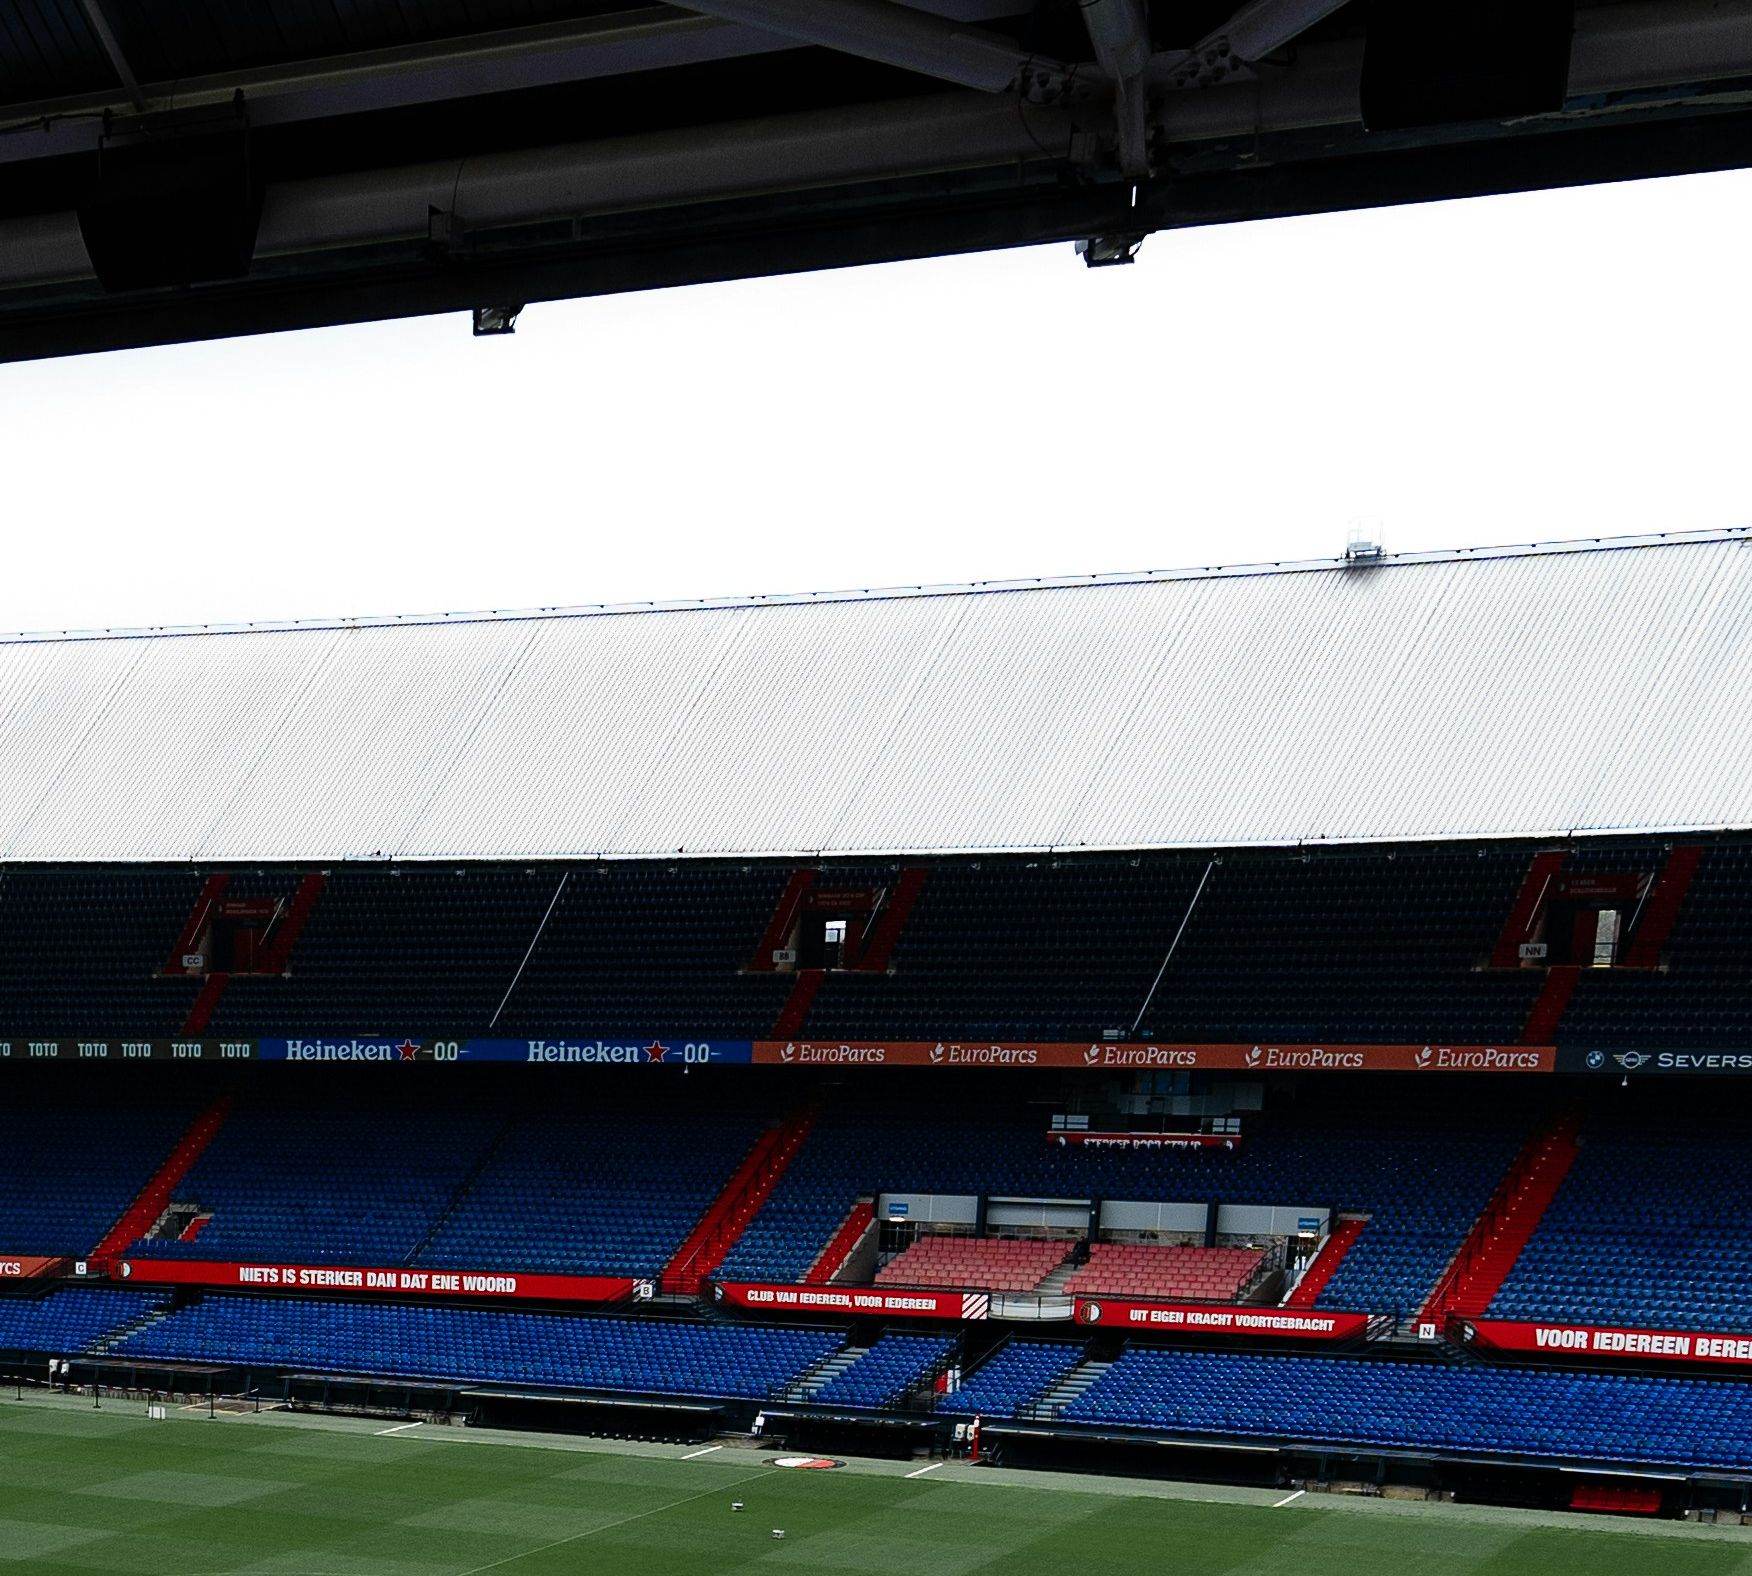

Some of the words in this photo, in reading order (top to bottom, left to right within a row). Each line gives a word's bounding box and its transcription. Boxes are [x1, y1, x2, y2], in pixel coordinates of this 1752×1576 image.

[1525, 946, 1541, 955] NN
[187, 957, 199, 965] CC
[28, 1042, 58, 1058] TOTO
[78, 1042, 107, 1058] TOTO
[121, 1042, 151, 1058] TOTO
[171, 1042, 201, 1058] TOTO
[220, 1042, 250, 1058] TOTO
[285, 1040, 393, 1061] Heineken
[526, 1040, 640, 1062] Heineken
[799, 1044, 885, 1062] EuroParcs
[948, 1045, 1038, 1063] EuroParcs
[1104, 1046, 1197, 1065] EuroParcs
[1266, 1048, 1364, 1067] EuroParcs
[1437, 1048, 1540, 1068] EuroParcs
[78, 1264, 84, 1272] C
[239, 1267, 279, 1283] NIETS
[282, 1269, 296, 1284] IS
[299, 1270, 363, 1287] STERKER
[366, 1272, 396, 1288] DAN
[400, 1273, 428, 1289] DAT
[431, 1275, 459, 1291] ENE
[462, 1276, 516, 1292] WOORD
[643, 1286, 650, 1295] B
[747, 1290, 774, 1303] CLUB
[776, 1290, 797, 1304] VAN
[799, 1291, 852, 1308] IEDEREEN,
[854, 1294, 883, 1308] VOOR
[884, 1296, 936, 1311] IEDEREEN
[1130, 1309, 1149, 1321] UIT
[1150, 1310, 1184, 1324] EIGEN
[1186, 1312, 1233, 1326] KRACHT
[1235, 1314, 1335, 1331] VOORTGEBRACHT
[1423, 1327, 1431, 1336] N
[1535, 1328, 1587, 1349] VOOR
[1592, 1331, 1690, 1355] IEDEREEN
